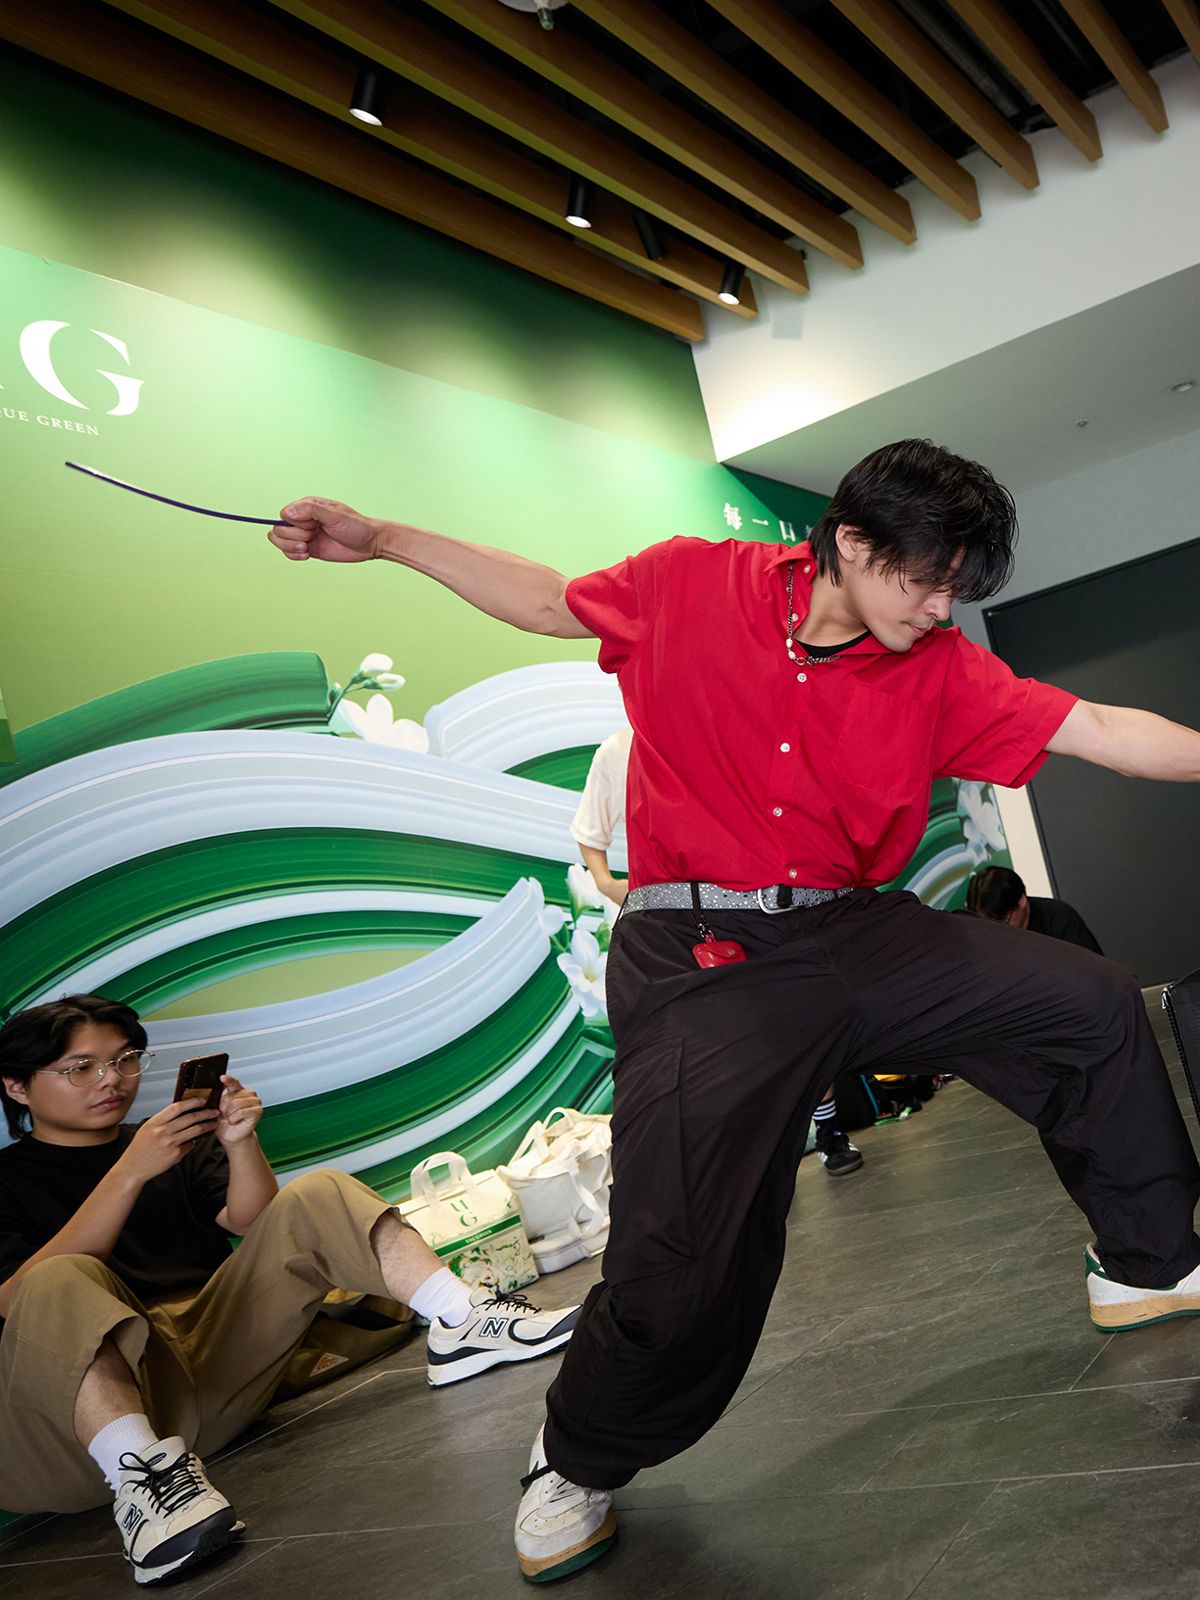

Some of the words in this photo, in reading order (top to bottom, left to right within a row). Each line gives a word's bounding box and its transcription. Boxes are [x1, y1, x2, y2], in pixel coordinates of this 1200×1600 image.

[0, 407, 29, 421] UE
[36, 415, 99, 436] GREEN
[723, 502, 814, 542] 每一口
